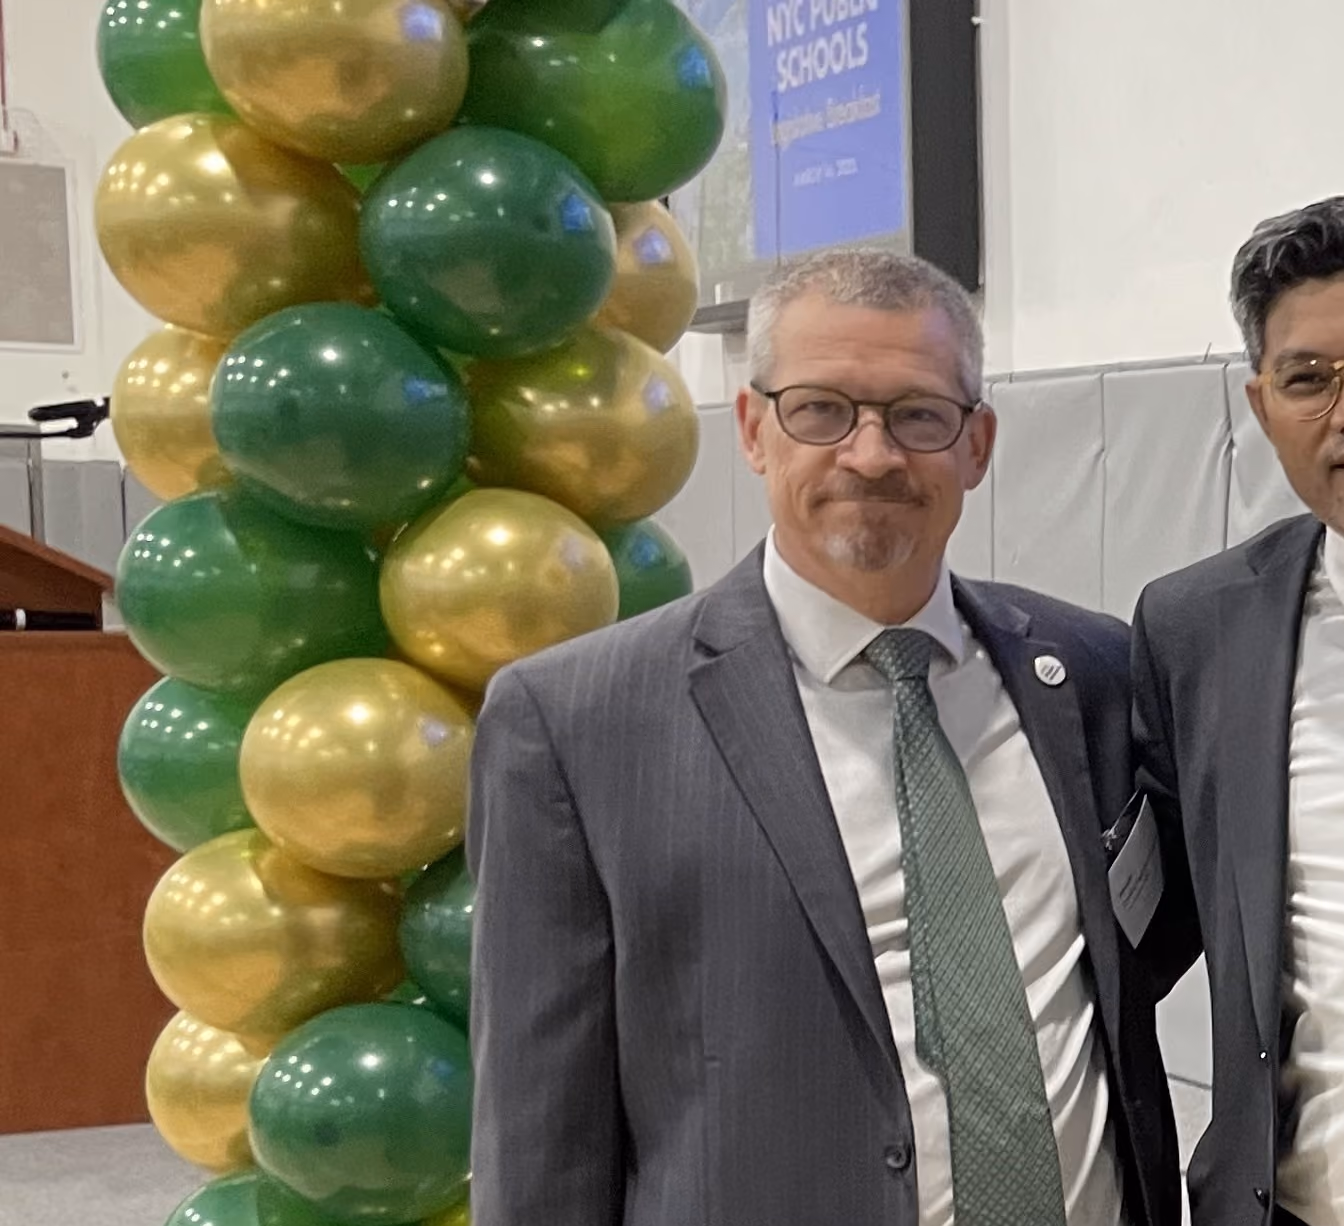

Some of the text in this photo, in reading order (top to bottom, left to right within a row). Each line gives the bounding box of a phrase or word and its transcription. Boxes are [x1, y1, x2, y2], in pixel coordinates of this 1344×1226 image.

[767, 0, 878, 47] NYC PUB
[777, 21, 868, 94] SCHOOLS
